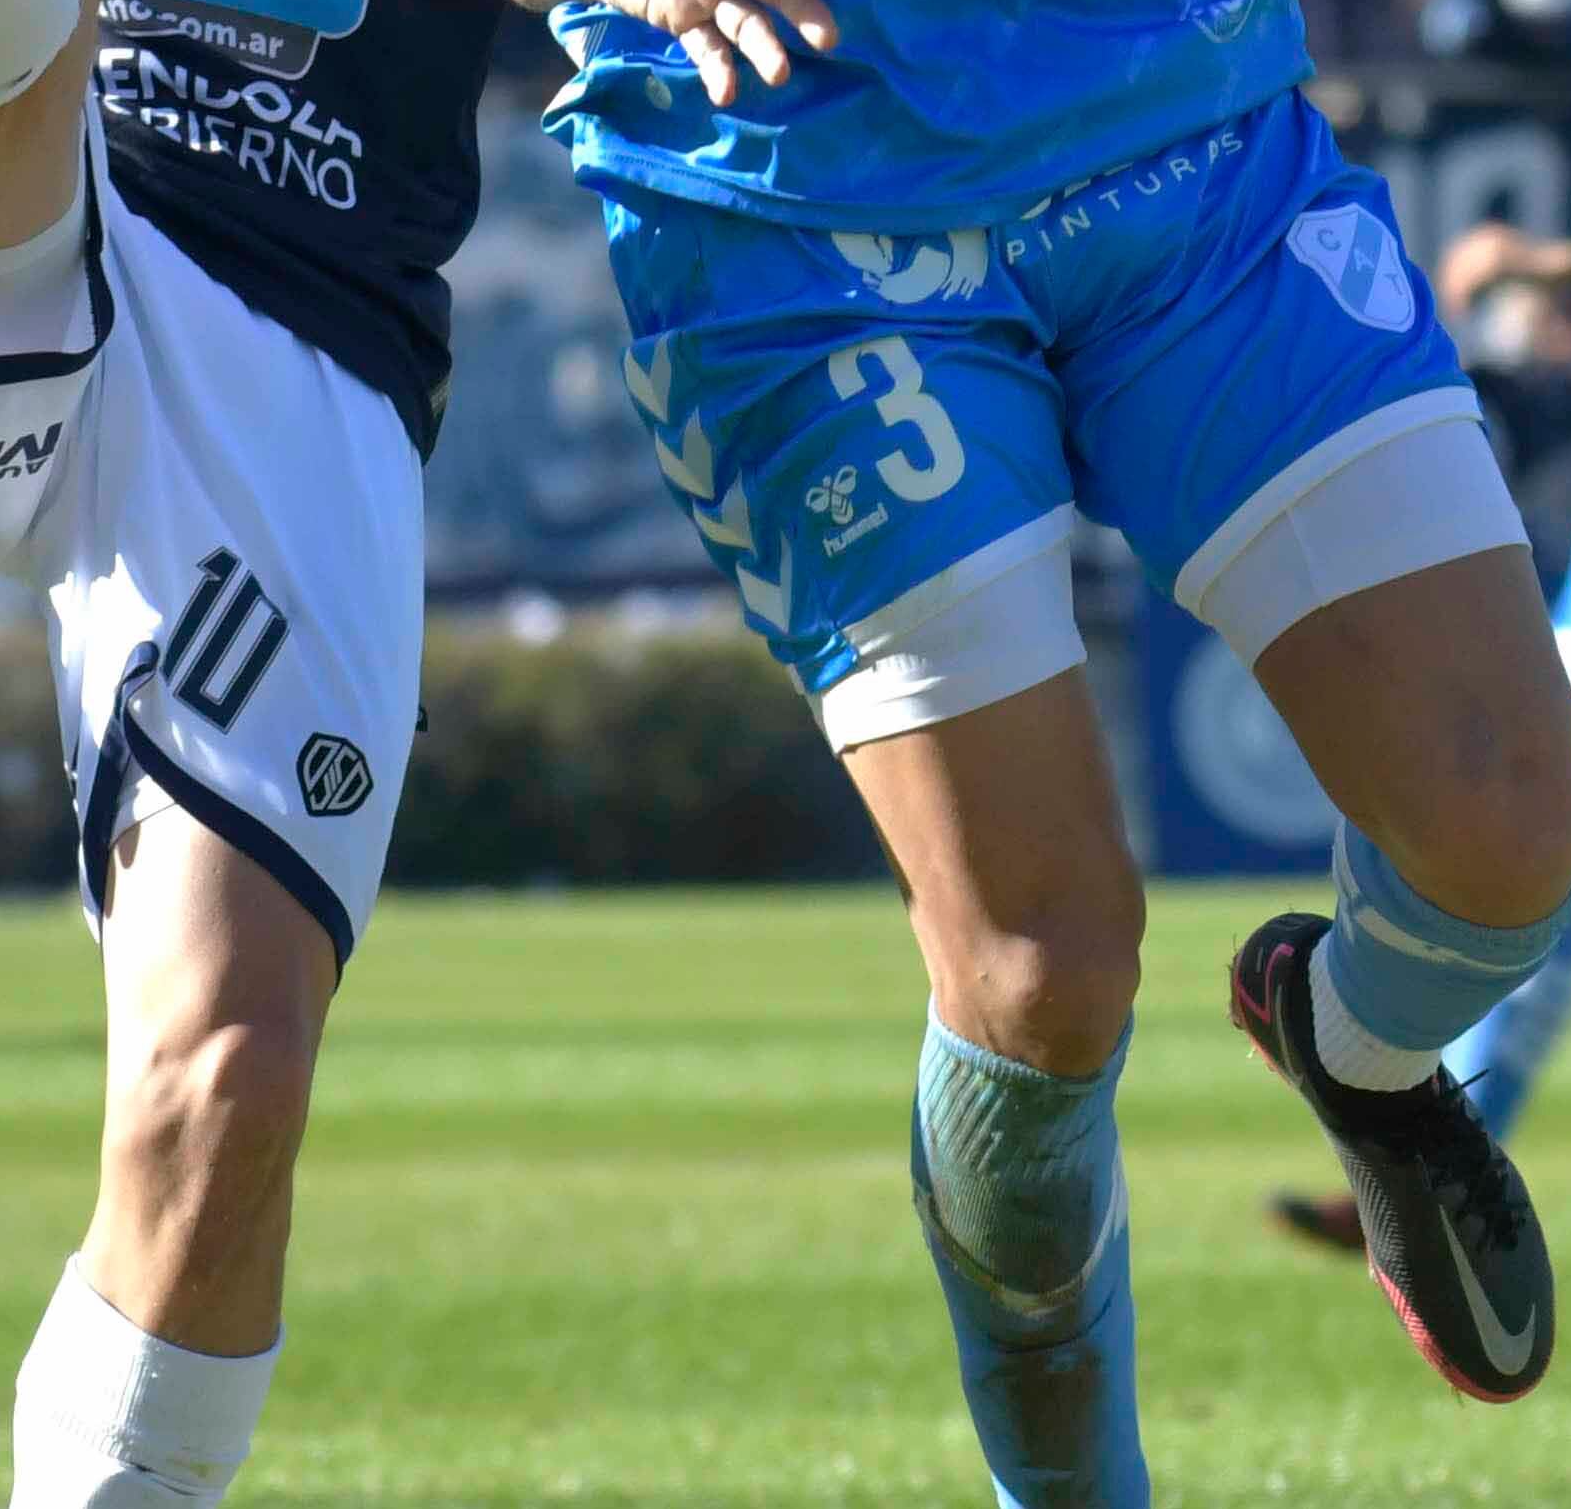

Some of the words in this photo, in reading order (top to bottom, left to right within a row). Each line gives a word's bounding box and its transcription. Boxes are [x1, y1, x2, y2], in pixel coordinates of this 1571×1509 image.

[1006, 131, 1243, 265] PINTURAS
[829, 334, 966, 503] 3
[161, 546, 288, 735] 10
